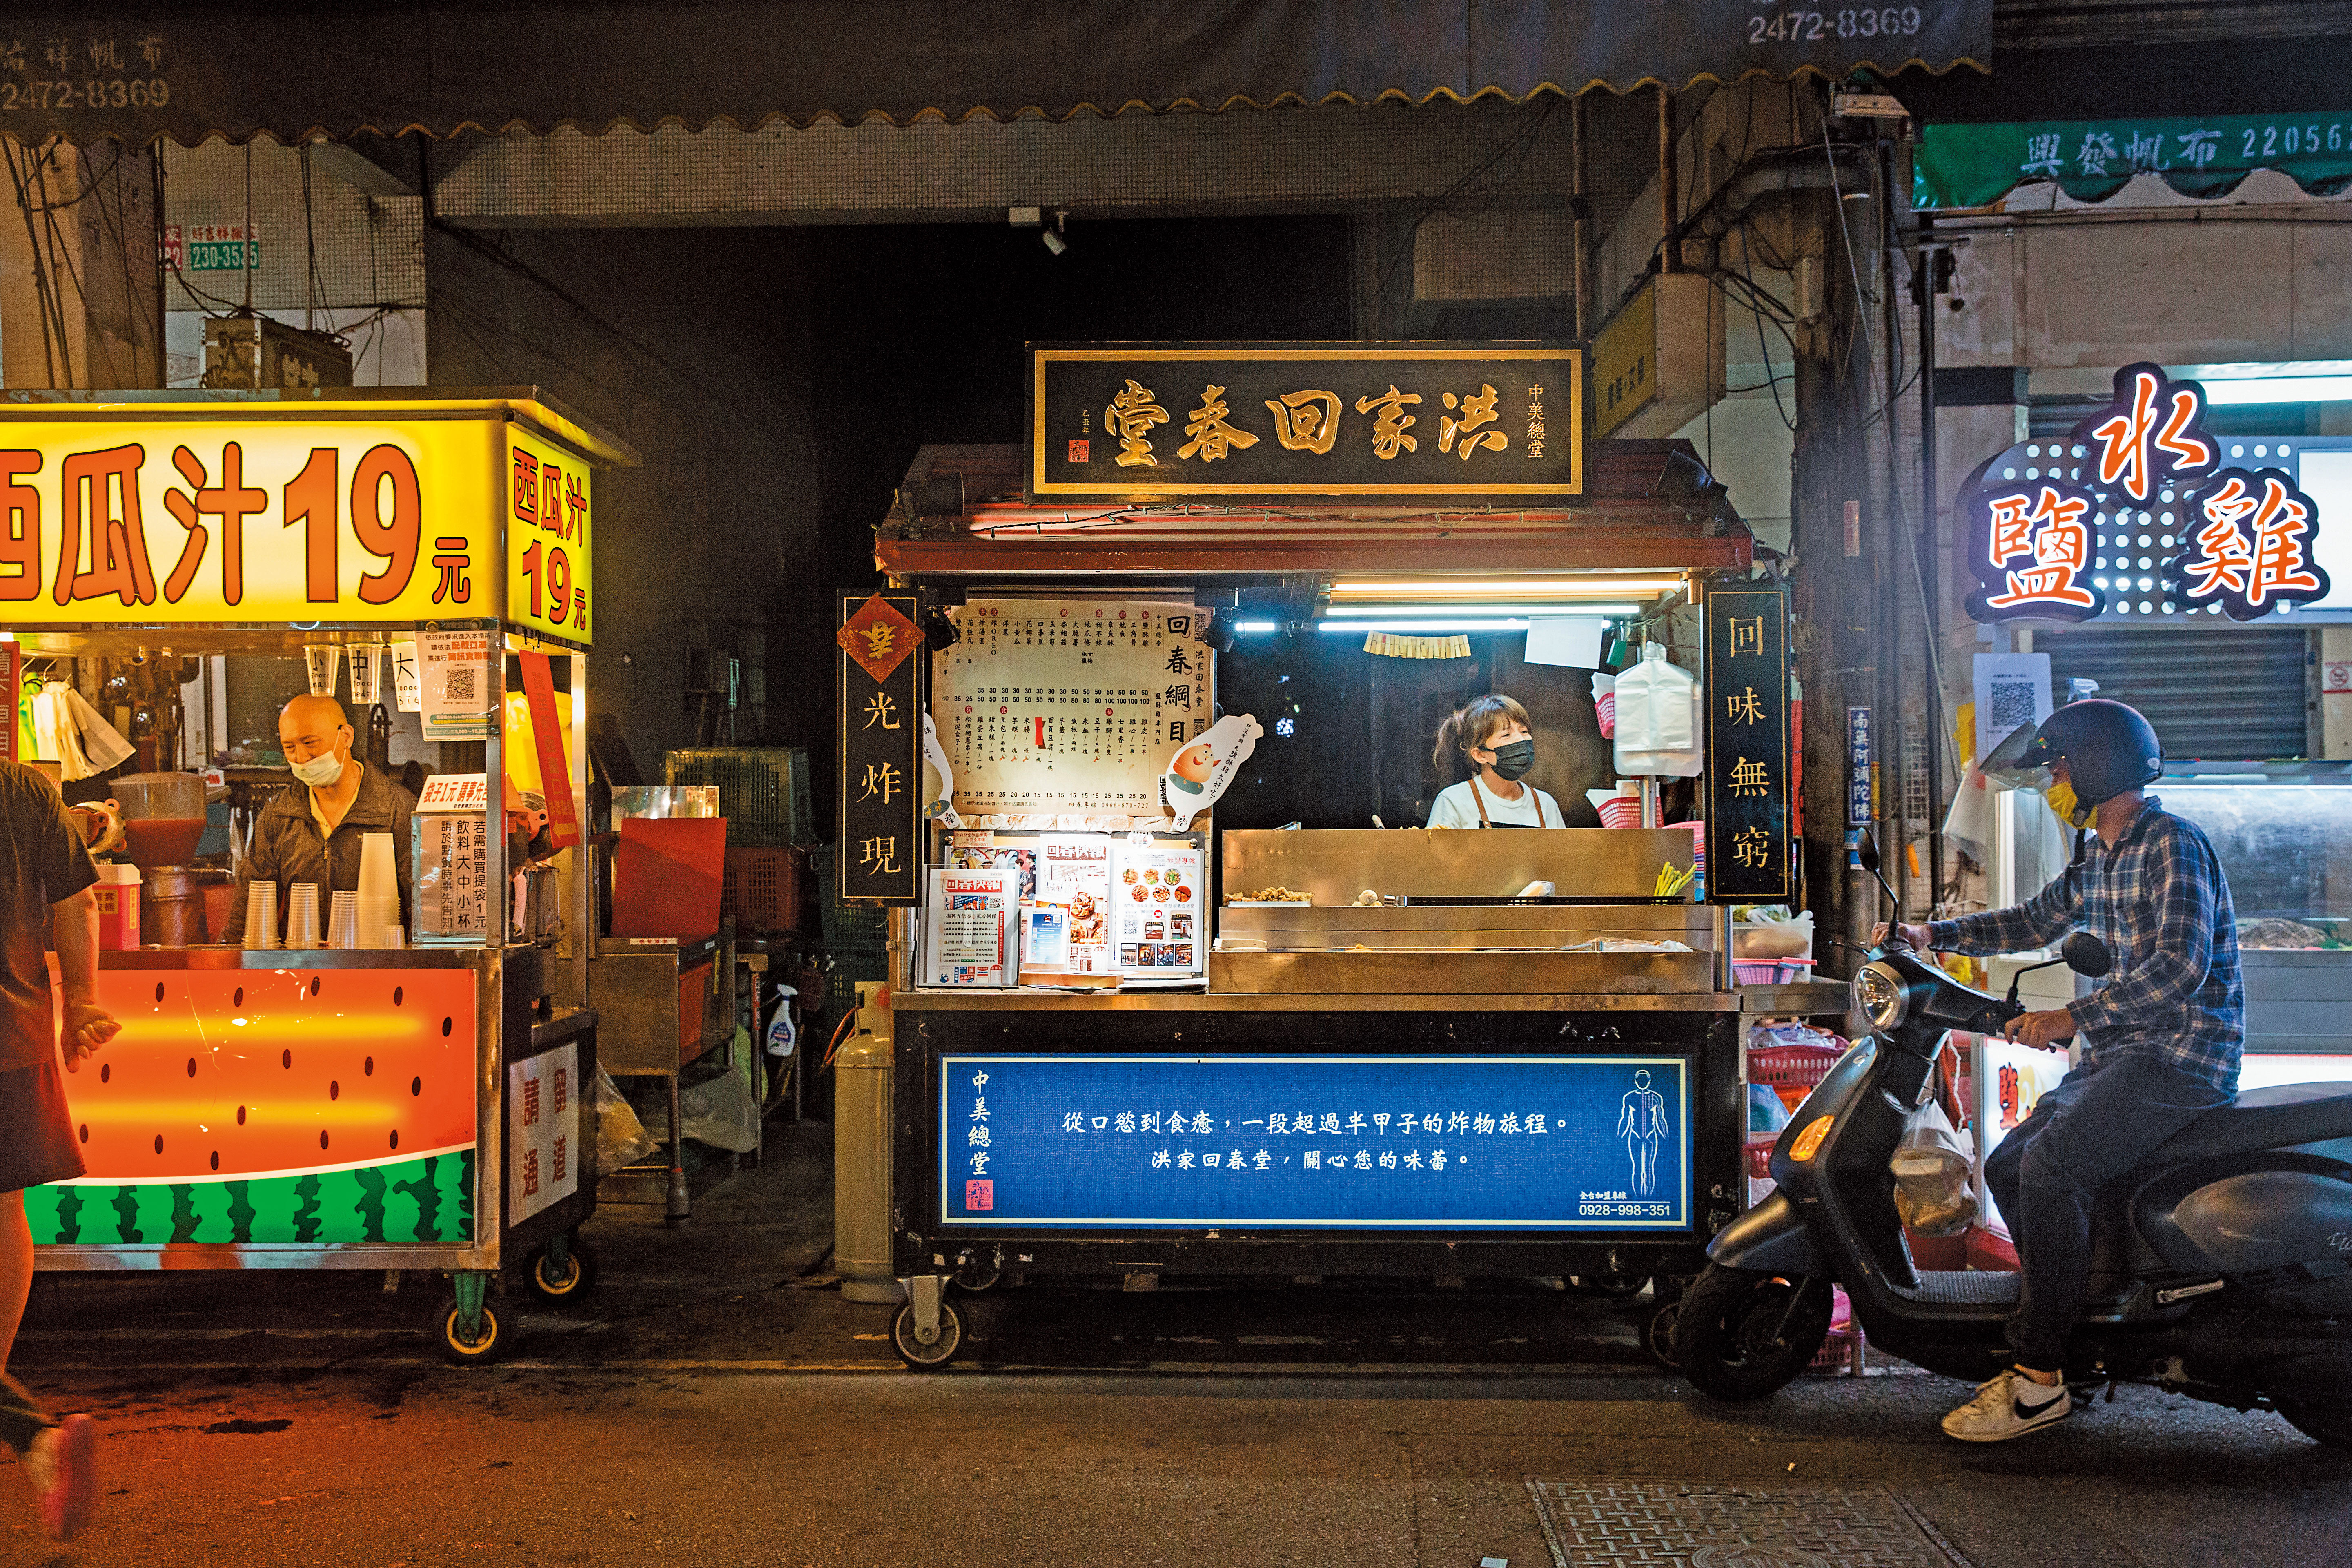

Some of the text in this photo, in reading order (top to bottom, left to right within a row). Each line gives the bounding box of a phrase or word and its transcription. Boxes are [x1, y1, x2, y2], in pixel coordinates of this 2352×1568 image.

[1748, 6, 1921, 44] 2472-8369
[1, 79, 169, 110] 2472-8369
[2242, 123, 2352, 158] 22056
[1082, 410, 1090, 435] 乙丑年
[1105, 378, 1508, 468] 洪家回春堂
[1527, 384, 1546, 458] 中美總堂
[512, 445, 588, 548] 西瓜汁
[522, 540, 587, 631] 19元
[1119, 621, 1126, 637] 魷魚
[352, 650, 368, 680] 中
[394, 653, 415, 682] 大
[1087, 651, 1093, 664] 甘梅
[1165, 616, 1192, 743] 回春綱目
[1195, 650, 1205, 708] 洪家回春堂
[1726, 615, 1770, 869] 回味無窮
[423, 782, 457, 803] 袋子1元
[1046, 844, 1105, 858] 回春快報
[441, 820, 453, 928] 請於點餐時事先告知
[457, 820, 470, 929] 飲料大中小杯
[474, 820, 486, 928] 若需購買提袋1元
[945, 879, 1001, 890] 回春快報
[967, 1069, 992, 1175] 中美總堂
[1061, 1110, 1566, 1136] 從口慾到食癒，一段超過半甲子的炸物旅程。
[1152, 1148, 1468, 1172] 洪家回春堂，關心您的味蕾。
[1579, 1190, 1628, 1200] 全台加盟專線
[1579, 1204, 1670, 1216] 0928-998-351
